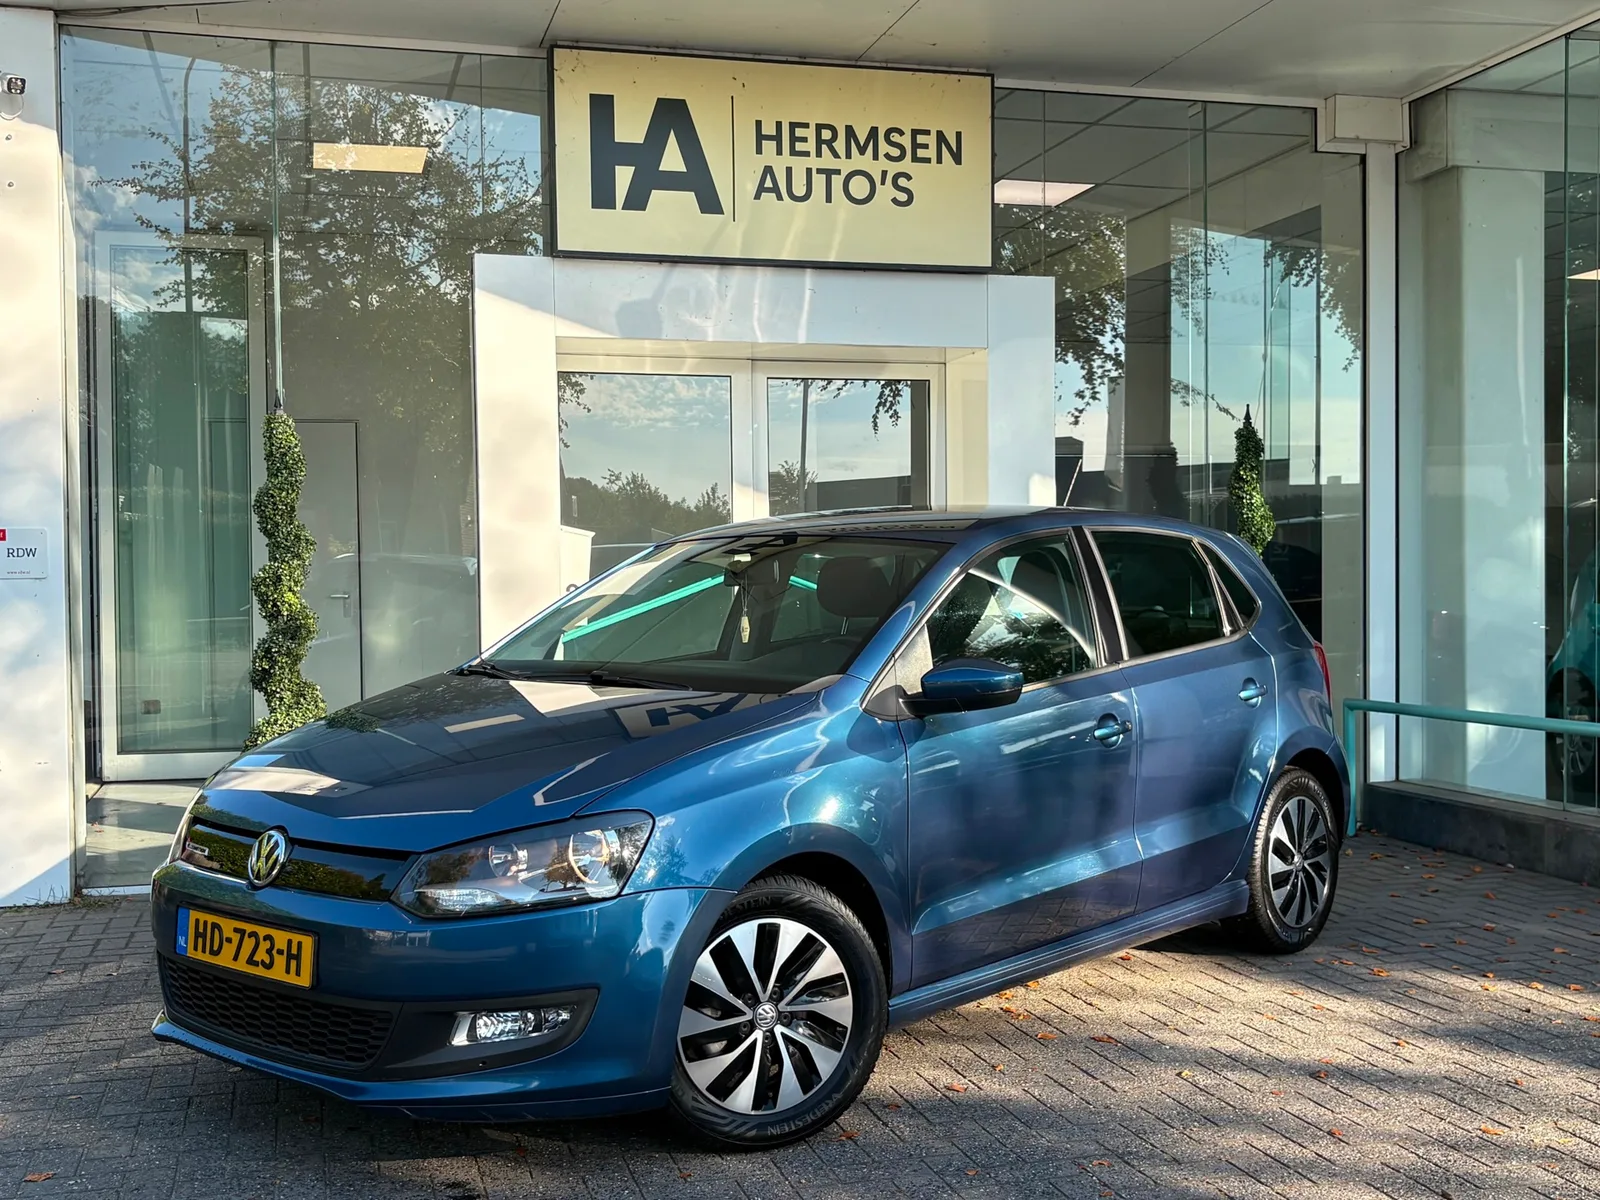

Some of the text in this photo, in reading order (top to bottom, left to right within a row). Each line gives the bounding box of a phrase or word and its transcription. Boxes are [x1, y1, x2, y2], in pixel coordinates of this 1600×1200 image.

[754, 119, 963, 166] HERMSEN
[753, 165, 915, 208] AUTO'S
[6, 547, 37, 558] RDW
[178, 935, 187, 947] NL
[193, 918, 303, 977] HD-723-H
